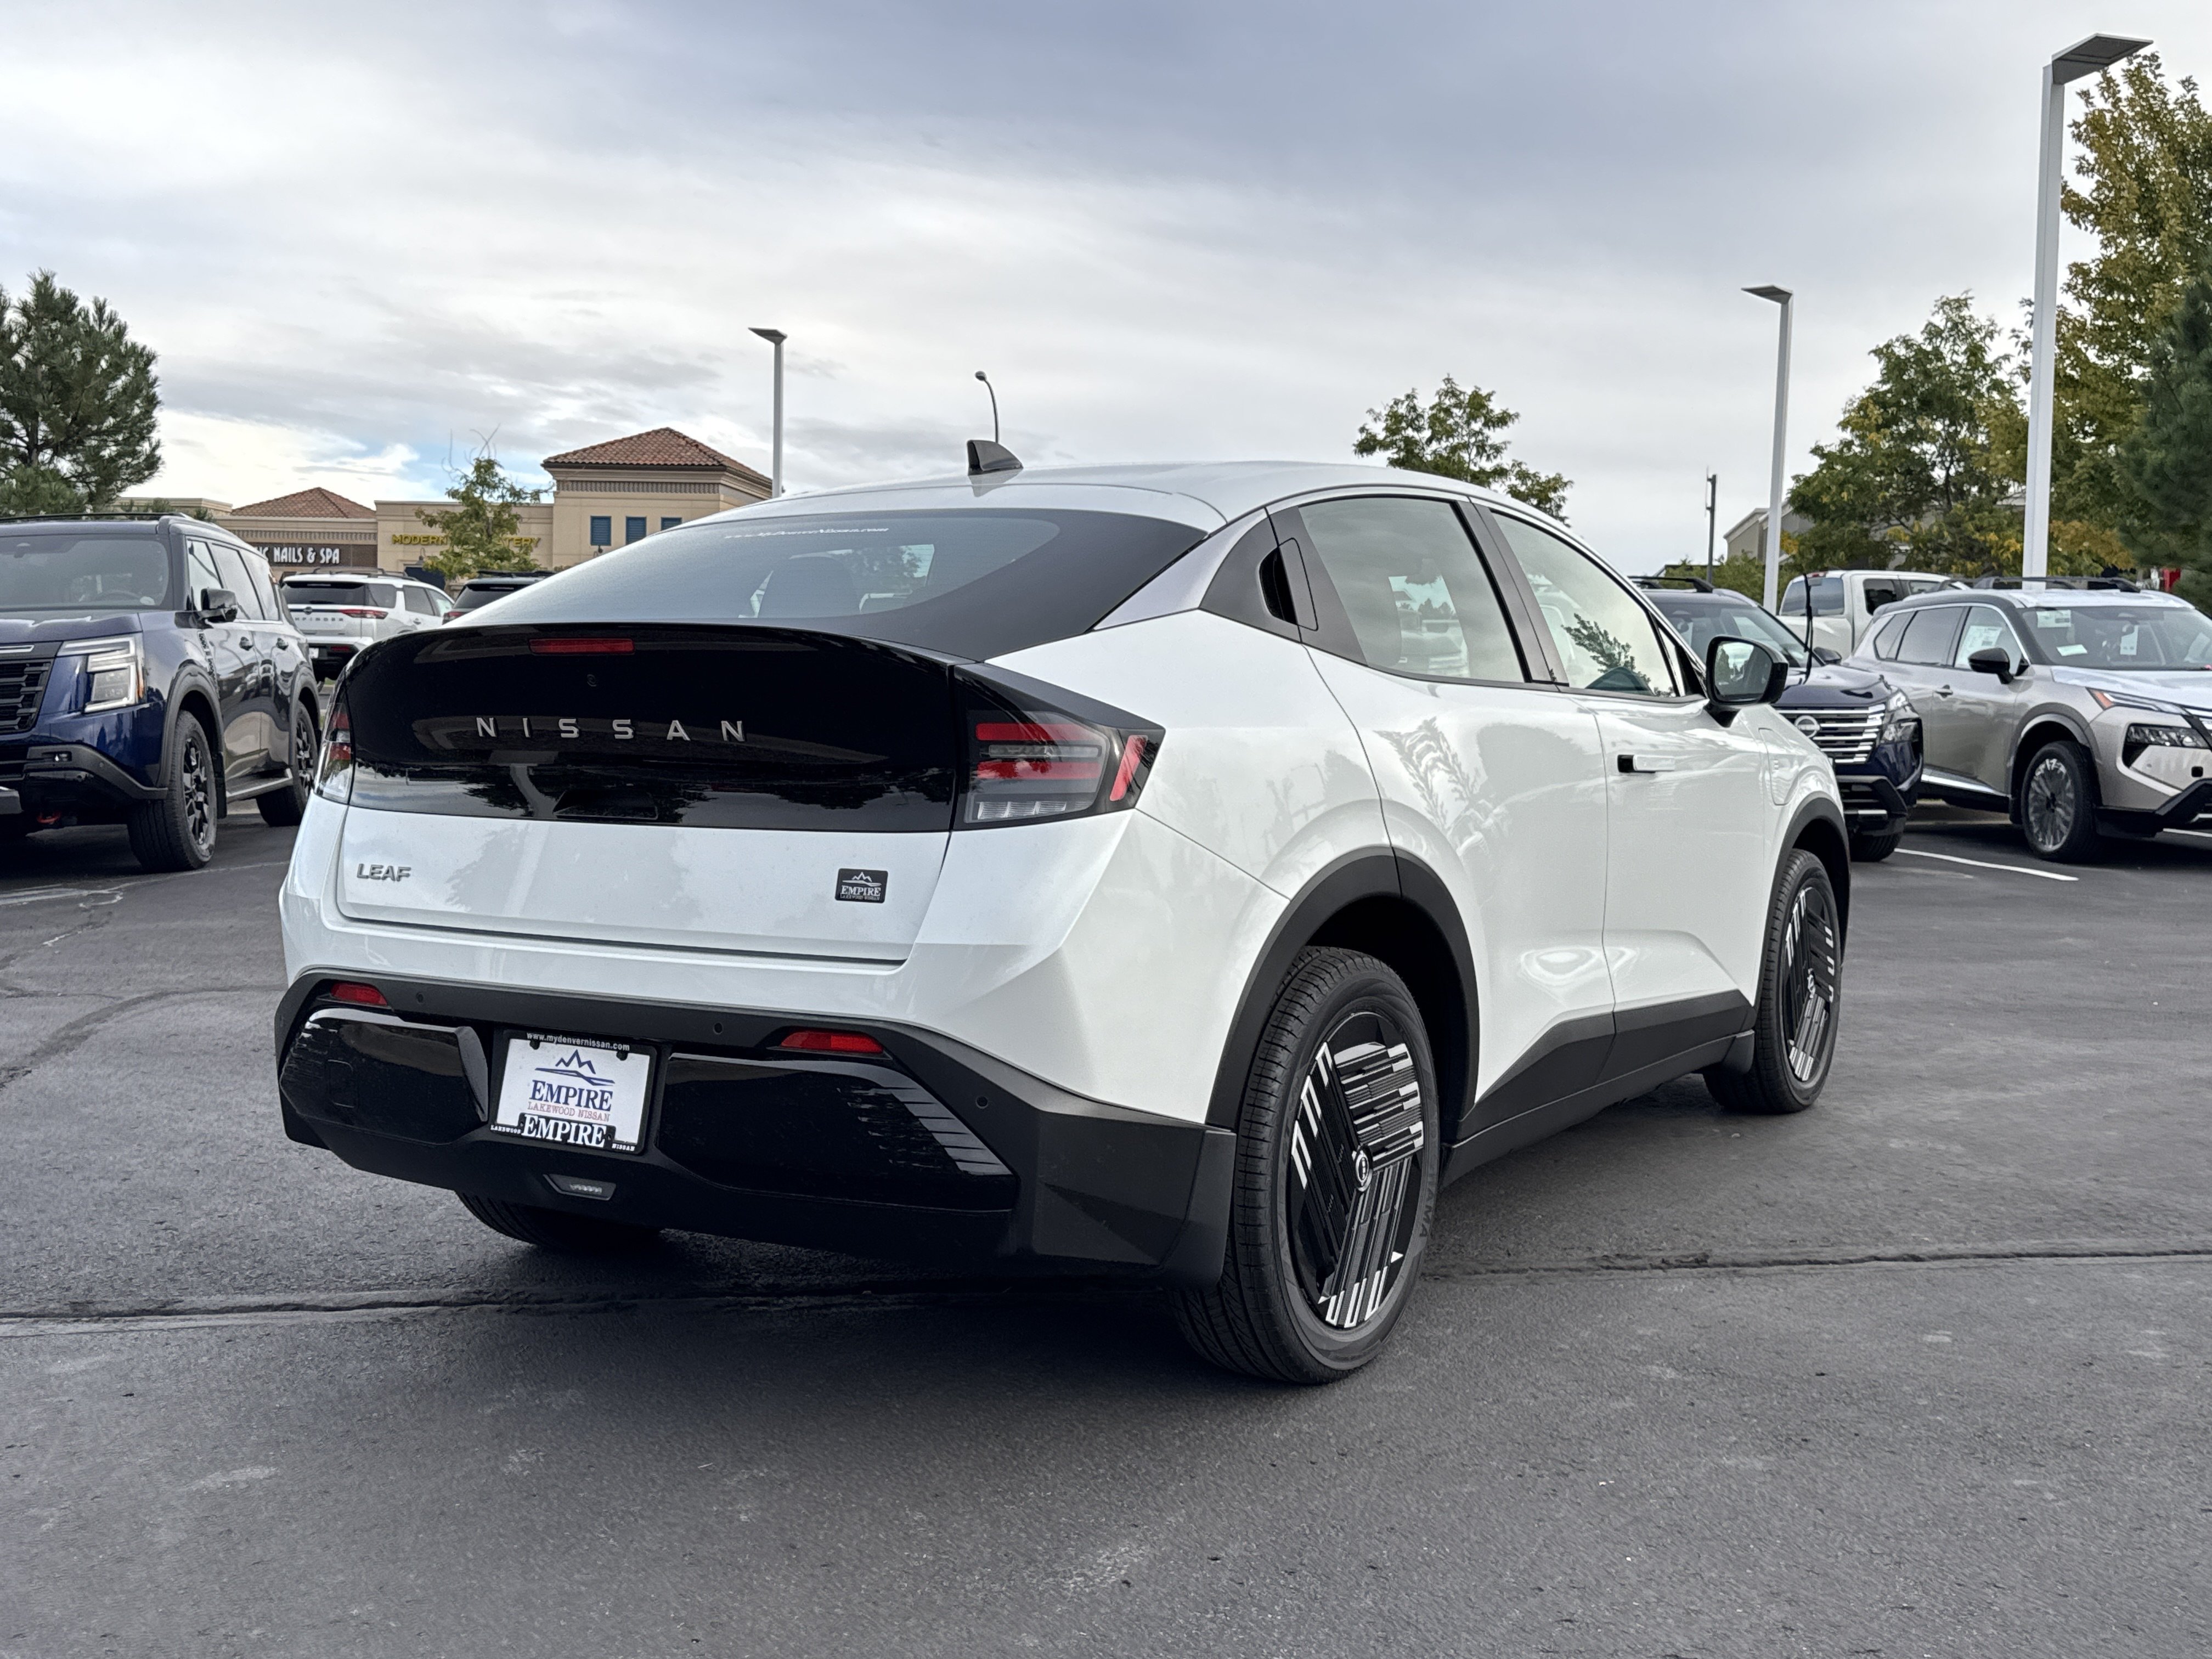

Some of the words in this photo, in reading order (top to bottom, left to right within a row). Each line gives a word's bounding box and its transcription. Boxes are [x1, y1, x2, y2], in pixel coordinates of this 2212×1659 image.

[392, 534, 449, 546] MODERN
[274, 546, 303, 563] NAILS
[307, 547, 316, 563] &
[320, 548, 340, 564] SPA
[476, 717, 745, 742] NISSAN
[357, 863, 411, 882] LEAF
[841, 885, 882, 897] EMPIRE
[527, 1032, 630, 1051] www.mydenvernissan.com
[529, 1079, 613, 1111] EMPIRE
[527, 1101, 575, 1116] LAKEWOOD
[578, 1109, 611, 1122] NISSAN
[521, 1114, 607, 1148] EMPIRE
